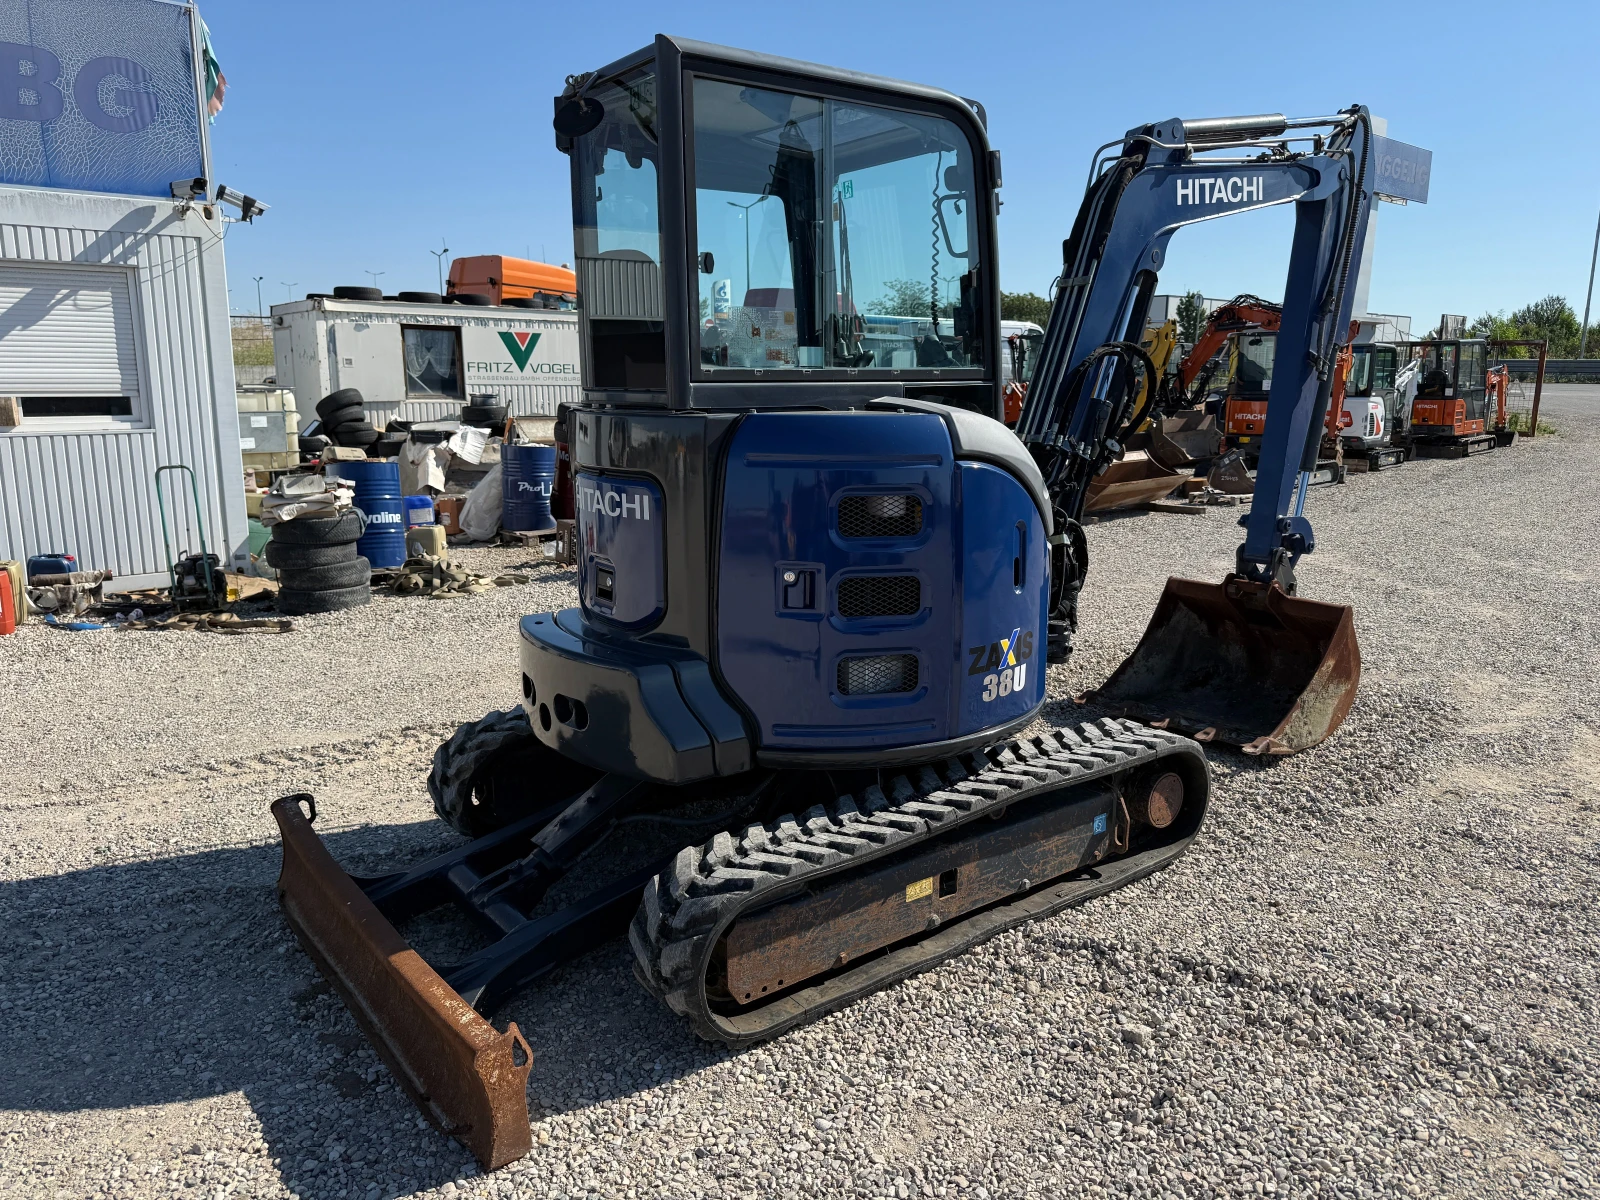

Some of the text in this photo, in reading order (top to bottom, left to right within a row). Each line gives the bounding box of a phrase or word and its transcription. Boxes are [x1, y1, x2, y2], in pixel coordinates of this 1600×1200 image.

[1176, 176, 1264, 206] HITACHI
[467, 361, 580, 375] FRITZ VOGEL
[576, 482, 650, 521] HITACHI
[967, 627, 1034, 677] ZAXIS
[982, 663, 1027, 702] 38U
